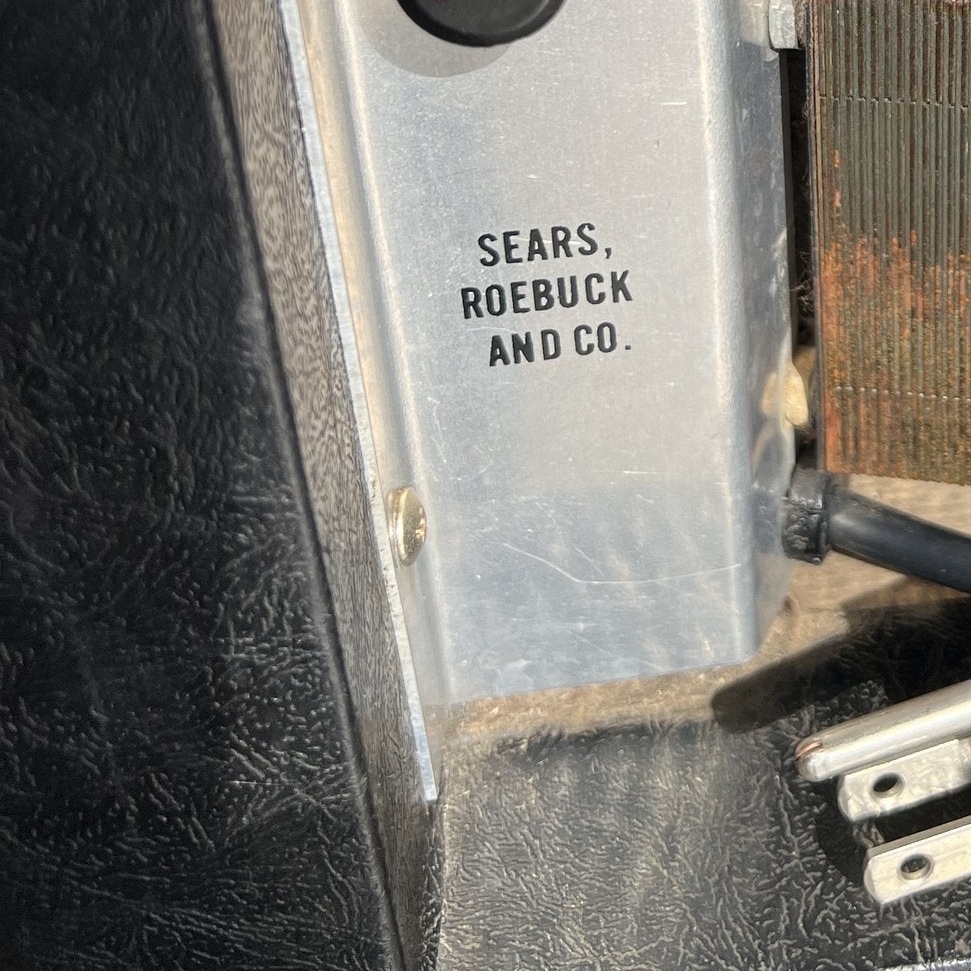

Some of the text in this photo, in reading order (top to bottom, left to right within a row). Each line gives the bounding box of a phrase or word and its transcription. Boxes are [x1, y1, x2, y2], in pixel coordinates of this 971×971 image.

[478, 222, 612, 266] SEARS,
[461, 270, 633, 319] ROEBUCK
[489, 322, 632, 366] AND CO.
